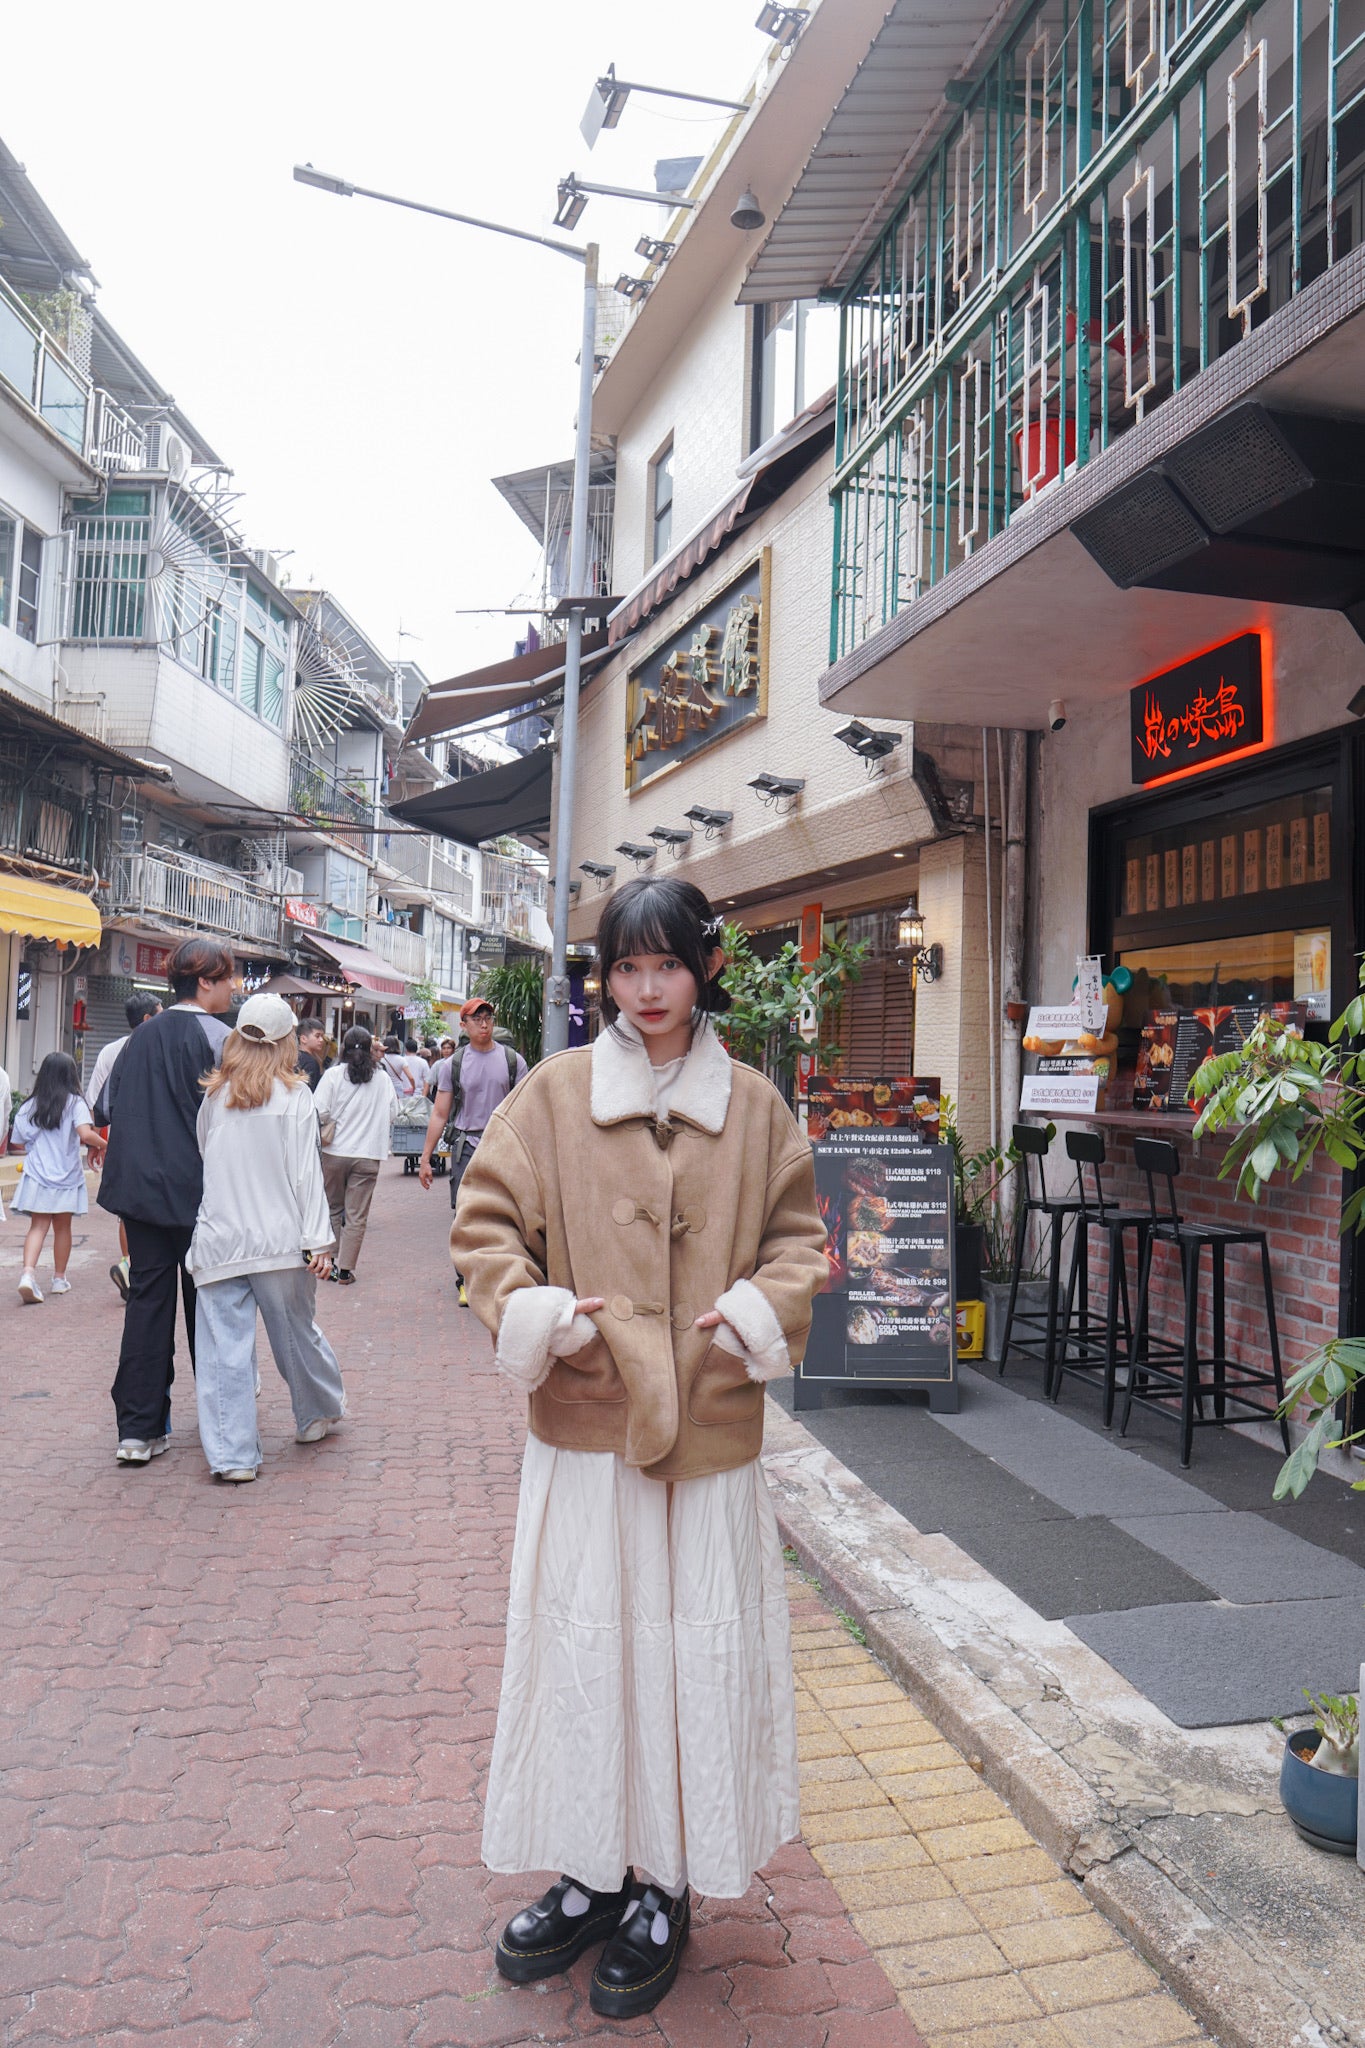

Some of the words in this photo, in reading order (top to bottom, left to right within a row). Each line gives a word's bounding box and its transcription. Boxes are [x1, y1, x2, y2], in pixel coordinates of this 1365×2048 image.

[931, 1201, 947, 1209] $118
[933, 1278, 947, 1286] $98
[927, 1317, 941, 1325] $78
